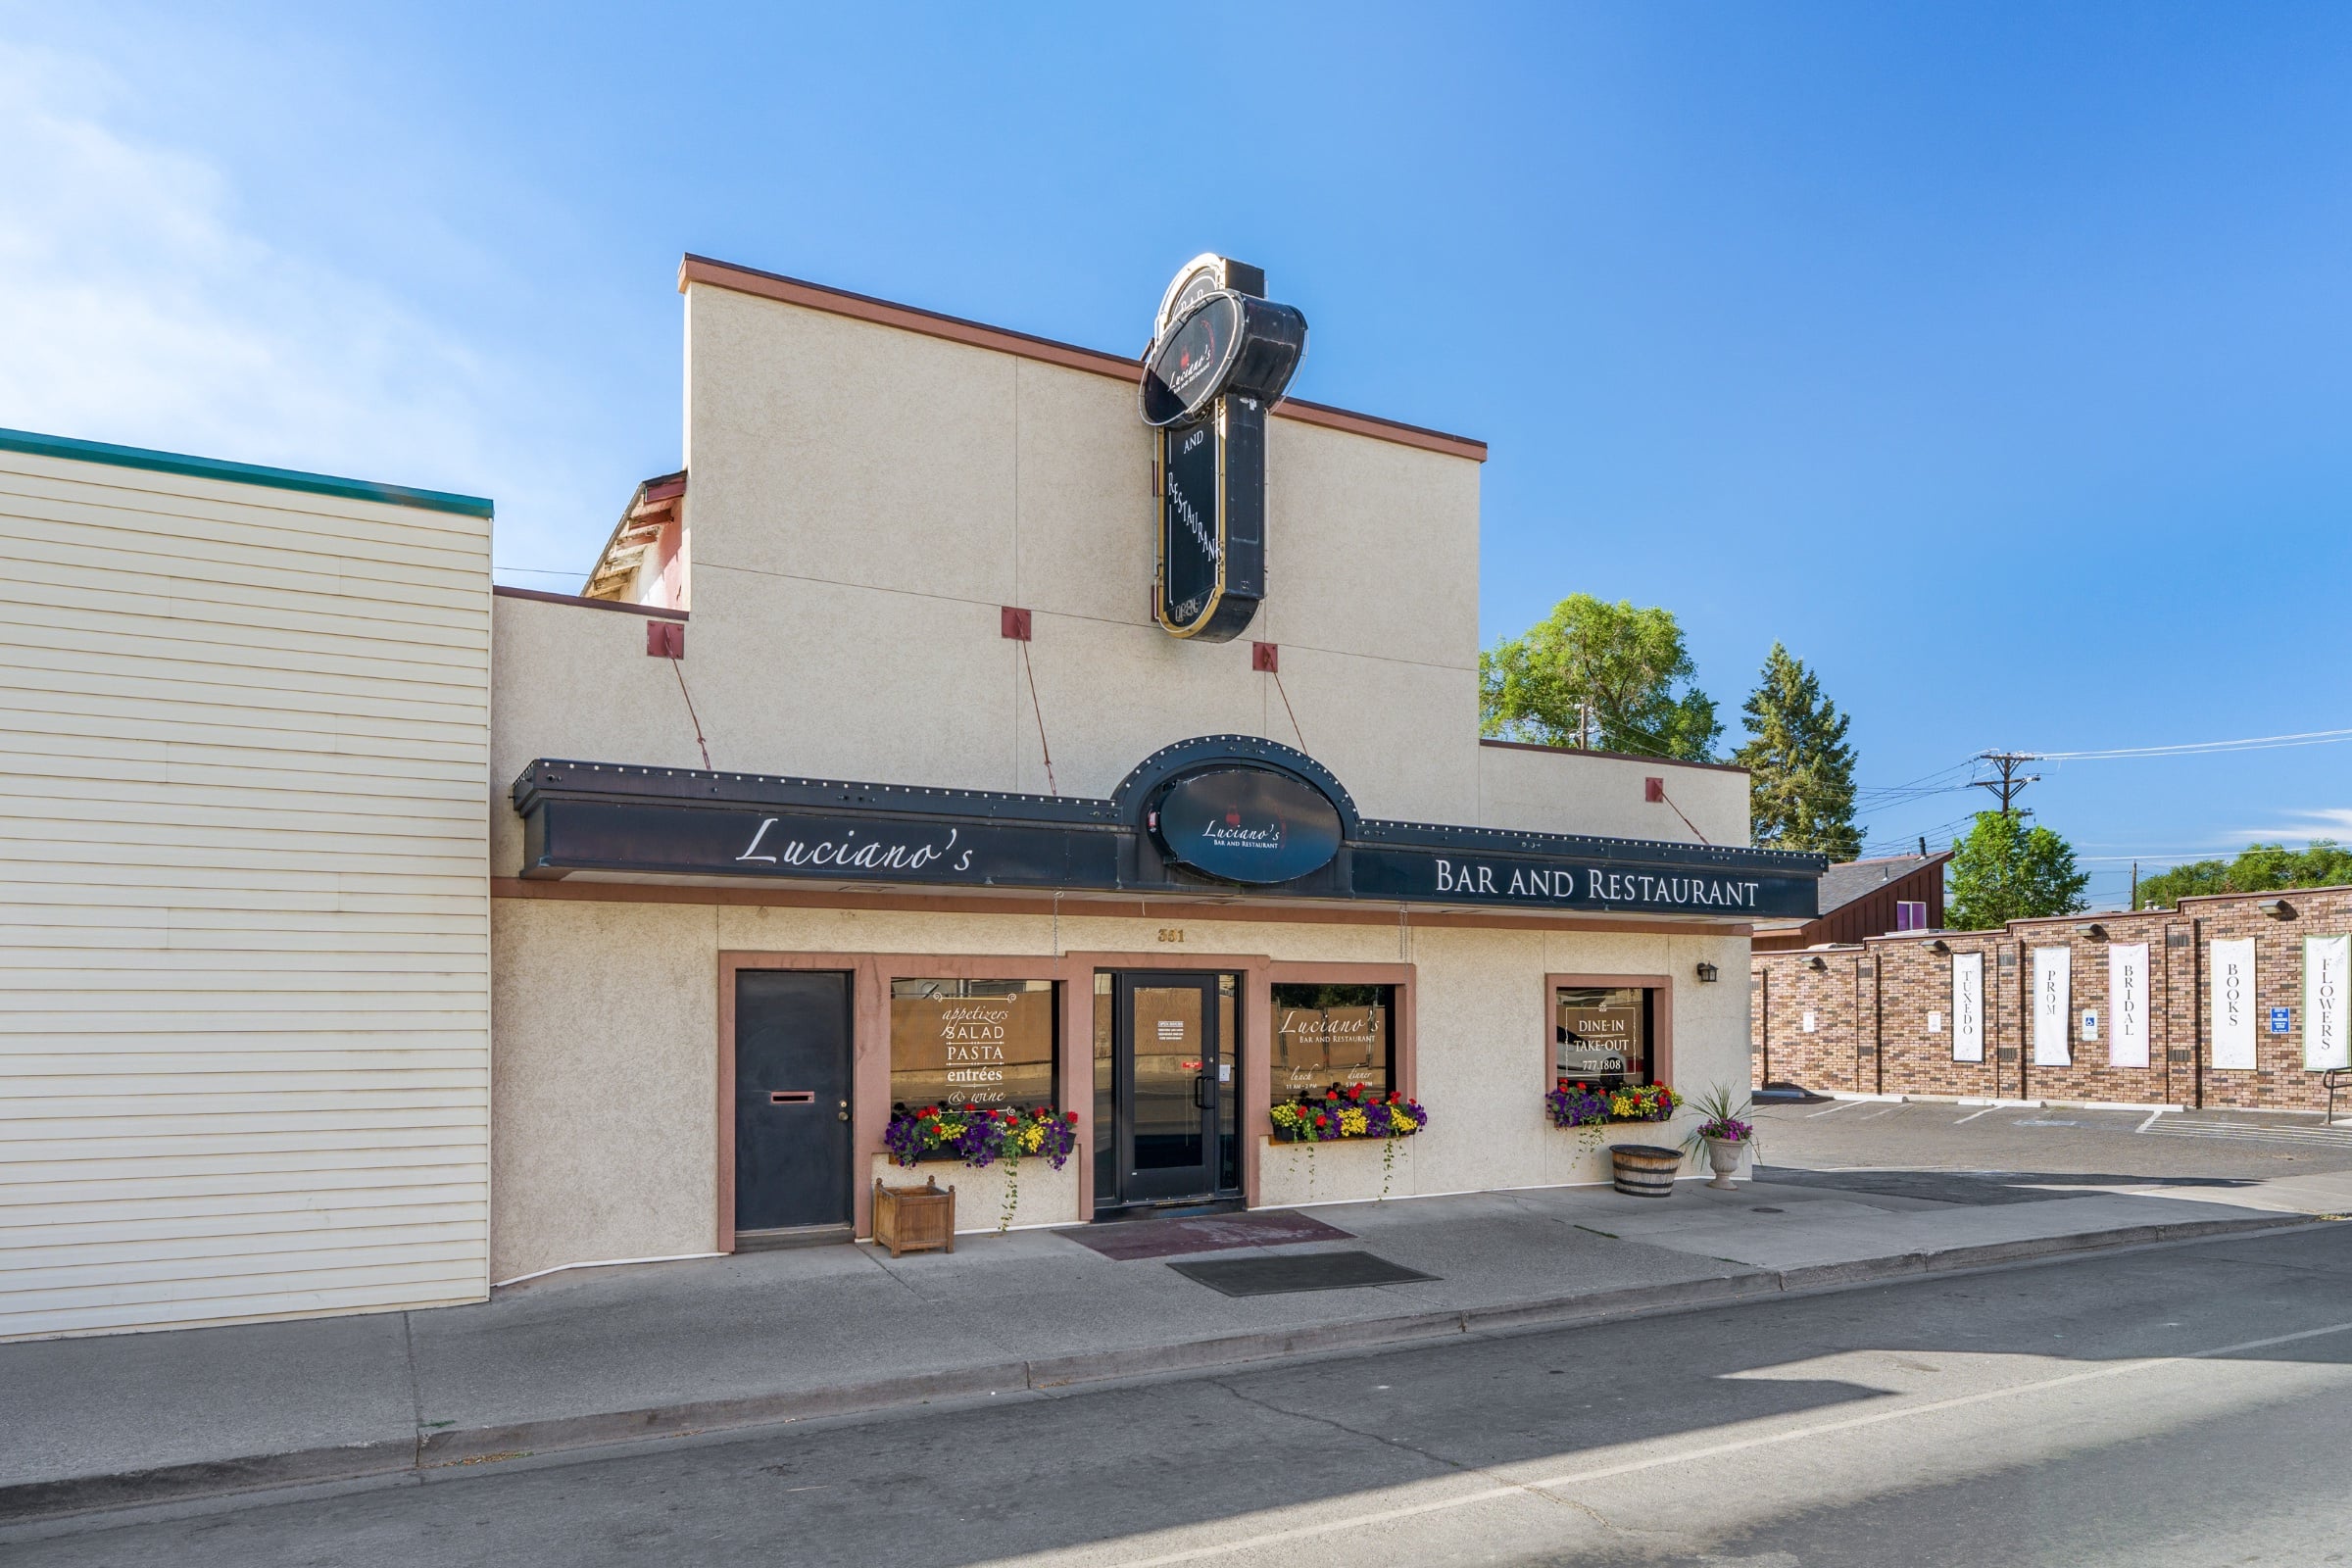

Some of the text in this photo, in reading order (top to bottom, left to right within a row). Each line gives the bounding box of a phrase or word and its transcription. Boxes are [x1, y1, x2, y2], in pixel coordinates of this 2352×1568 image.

[1167, 344, 1211, 392] Luciano's
[1183, 429, 1204, 455] AND
[1201, 819, 1280, 841] Luciano's
[735, 817, 974, 871] Luciano's
[1436, 859, 1759, 907] BAR AND RESTAURANT
[1962, 970, 1973, 1035] TUXEDO
[2046, 970, 2056, 1015] PROM
[2124, 964, 2134, 1036] BRIDAL
[2227, 963, 2239, 1027] BOOKS
[2319, 957, 2336, 1051] FLOWERS
[939, 1005, 1009, 1037] appetizers
[946, 1026, 1004, 1040] SALAD
[1278, 1009, 1380, 1034] Luciano's
[1579, 1019, 1625, 1032] DINE-IN
[947, 1046, 1004, 1060] PASTA
[1574, 1039, 1629, 1053] TAKE-OUT
[947, 1066, 1003, 1082] entrées
[1291, 1063, 1319, 1081] lunch
[1348, 1063, 1372, 1080] dinner
[1583, 1059, 1621, 1071] 777.1808
[948, 1088, 1006, 1105] & wine
